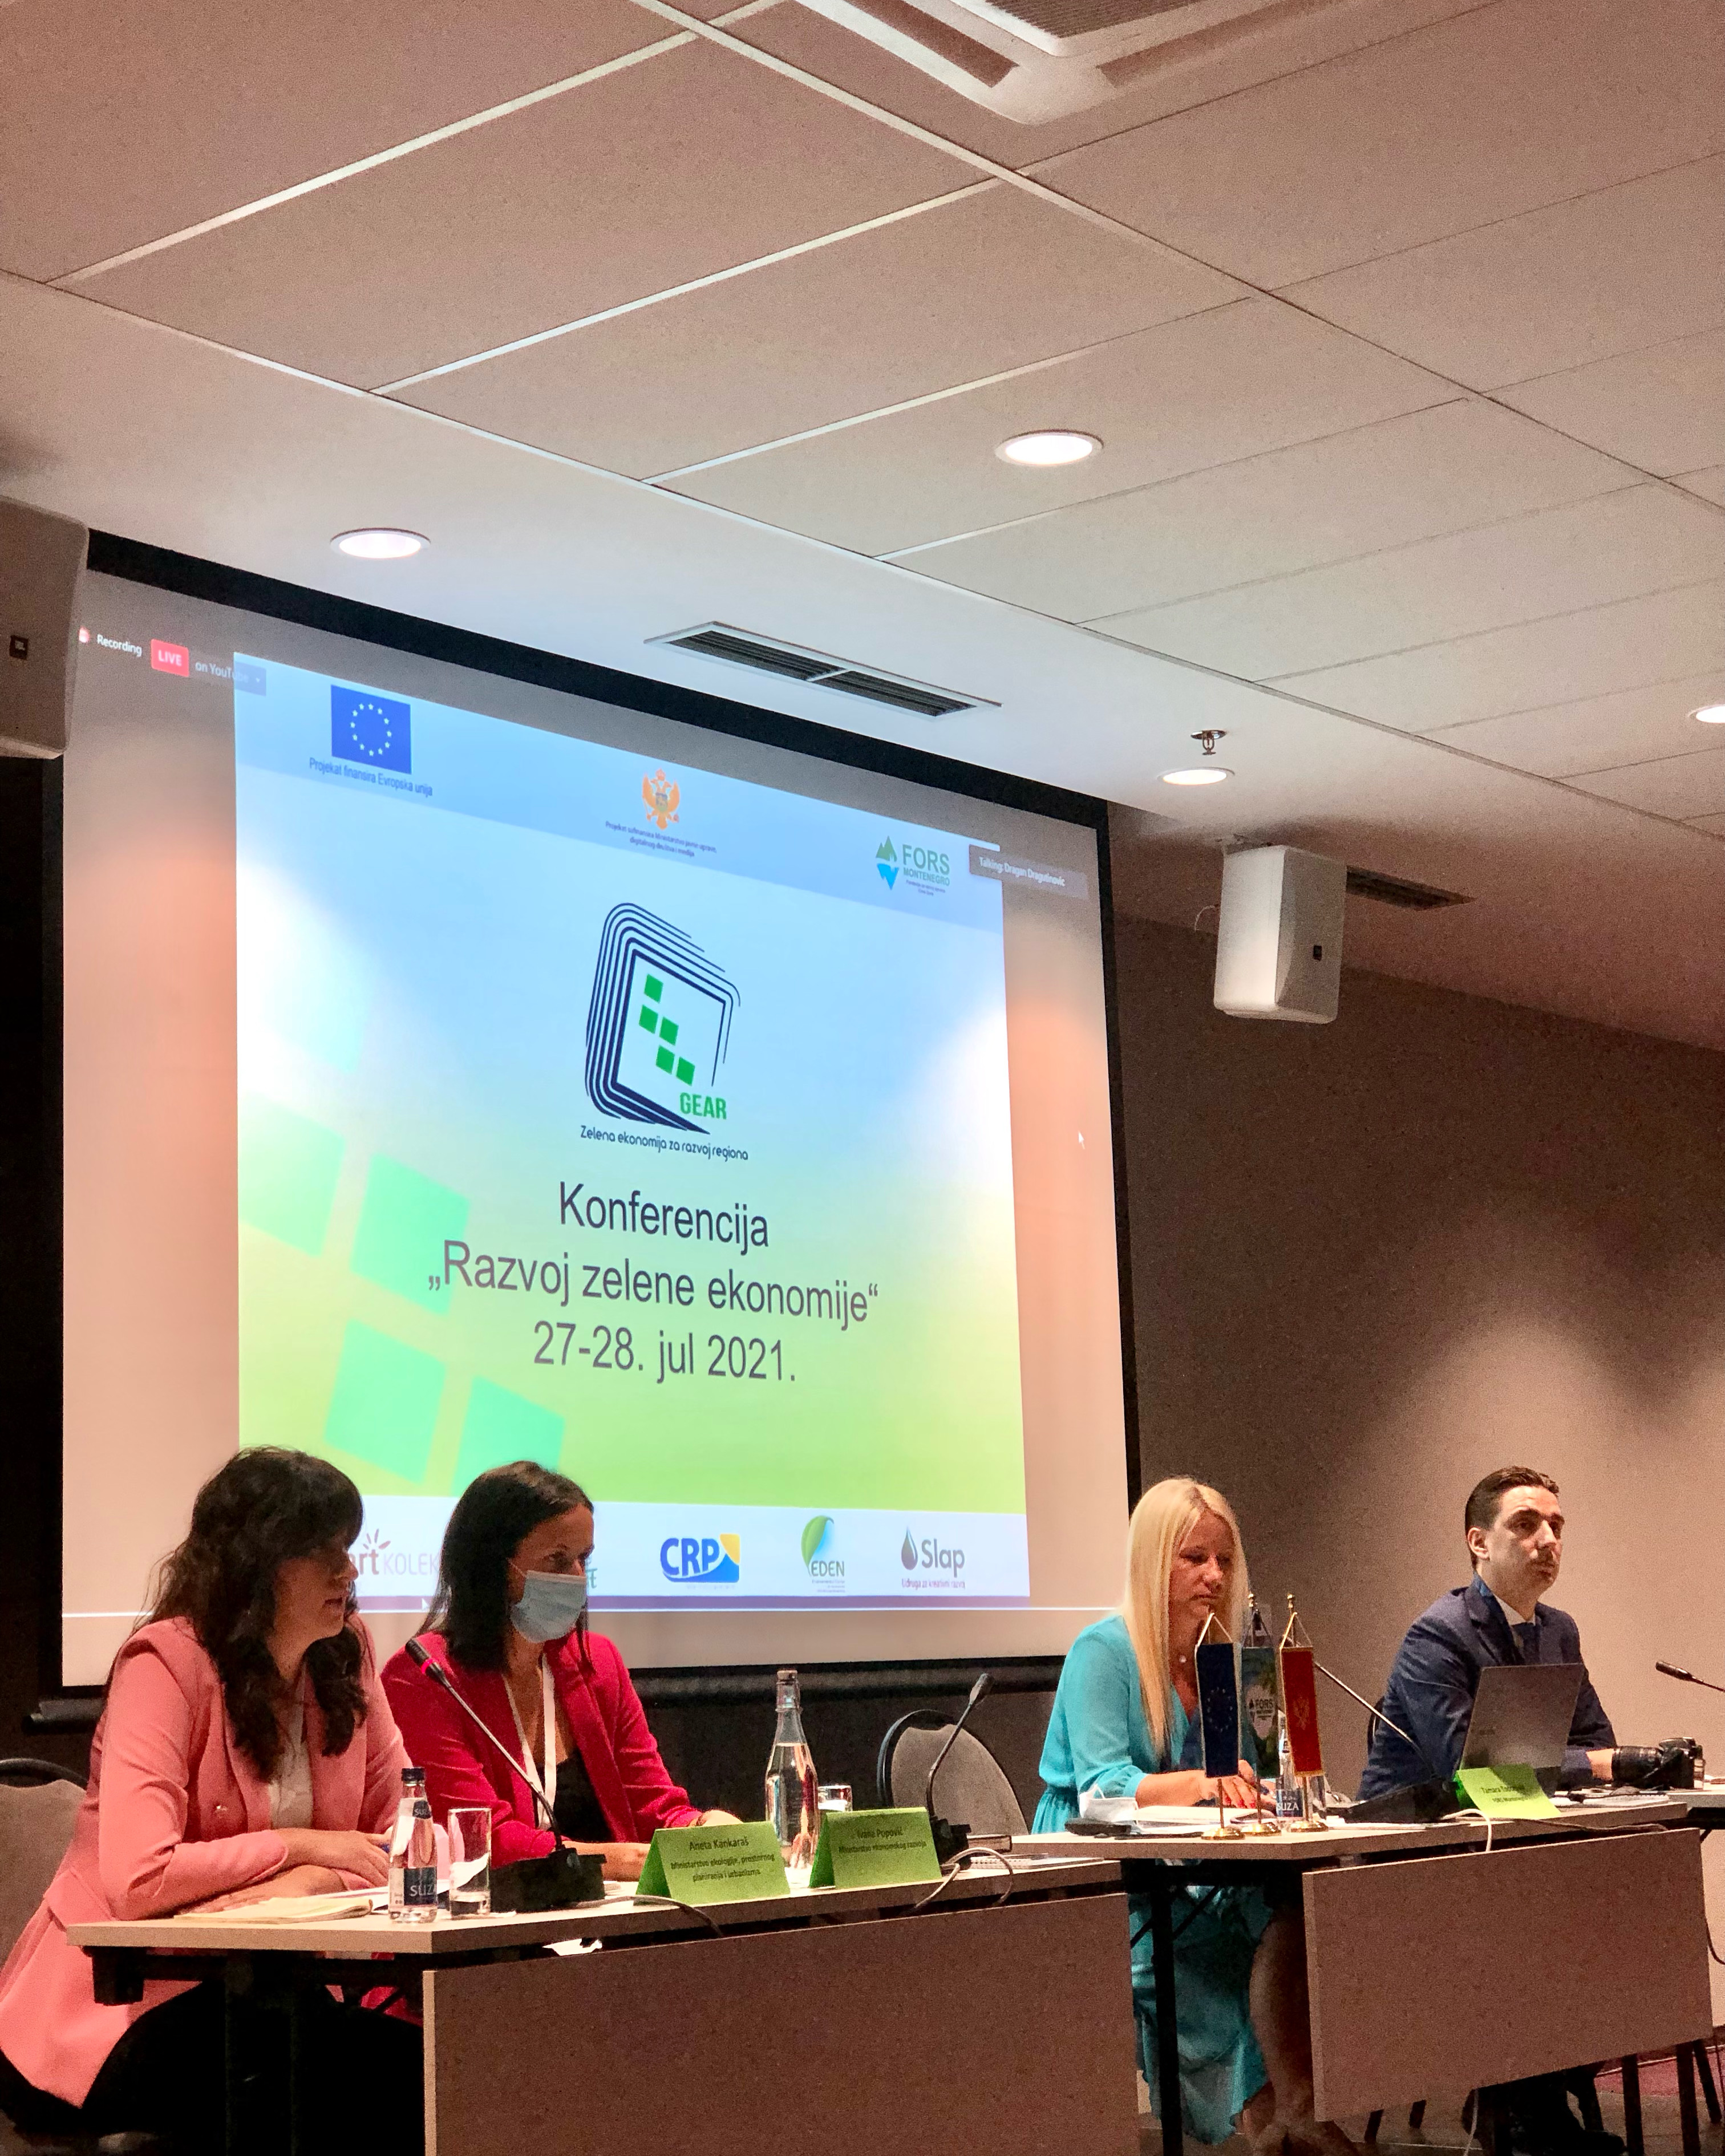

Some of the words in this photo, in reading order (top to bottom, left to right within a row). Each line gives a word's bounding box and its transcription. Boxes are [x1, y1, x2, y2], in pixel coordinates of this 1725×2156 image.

[97, 634, 142, 656] Recording
[158, 650, 182, 666] LIVE
[196, 661, 208, 672] on
[310, 757, 342, 775] Projekat
[344, 765, 376, 783] finansira
[378, 773, 413, 792] Evropska
[415, 783, 433, 797] unija
[902, 844, 950, 875] FORS
[904, 867, 950, 886] MONTENEGRO
[679, 1092, 727, 1120] GEAR
[580, 1125, 616, 1142] Zelena
[618, 1132, 667, 1153] ekonomija
[669, 1140, 680, 1151] za
[682, 1142, 711, 1160] razvoj
[712, 1145, 748, 1162] regiona
[559, 1181, 769, 1255] Konferencija
[582, 1258, 695, 1306] zelene
[533, 1320, 644, 1371] 27-28.
[656, 1330, 694, 1384] jul
[708, 1334, 796, 1382] 2021.
[660, 1538, 720, 1577] CRP
[811, 1561, 844, 1577] EDEN
[921, 1538, 965, 1578] Slap
[1277, 1802, 1299, 1811] SUZA
[689, 1841, 712, 1851] Aneta
[713, 1837, 749, 1849] Kankaraš
